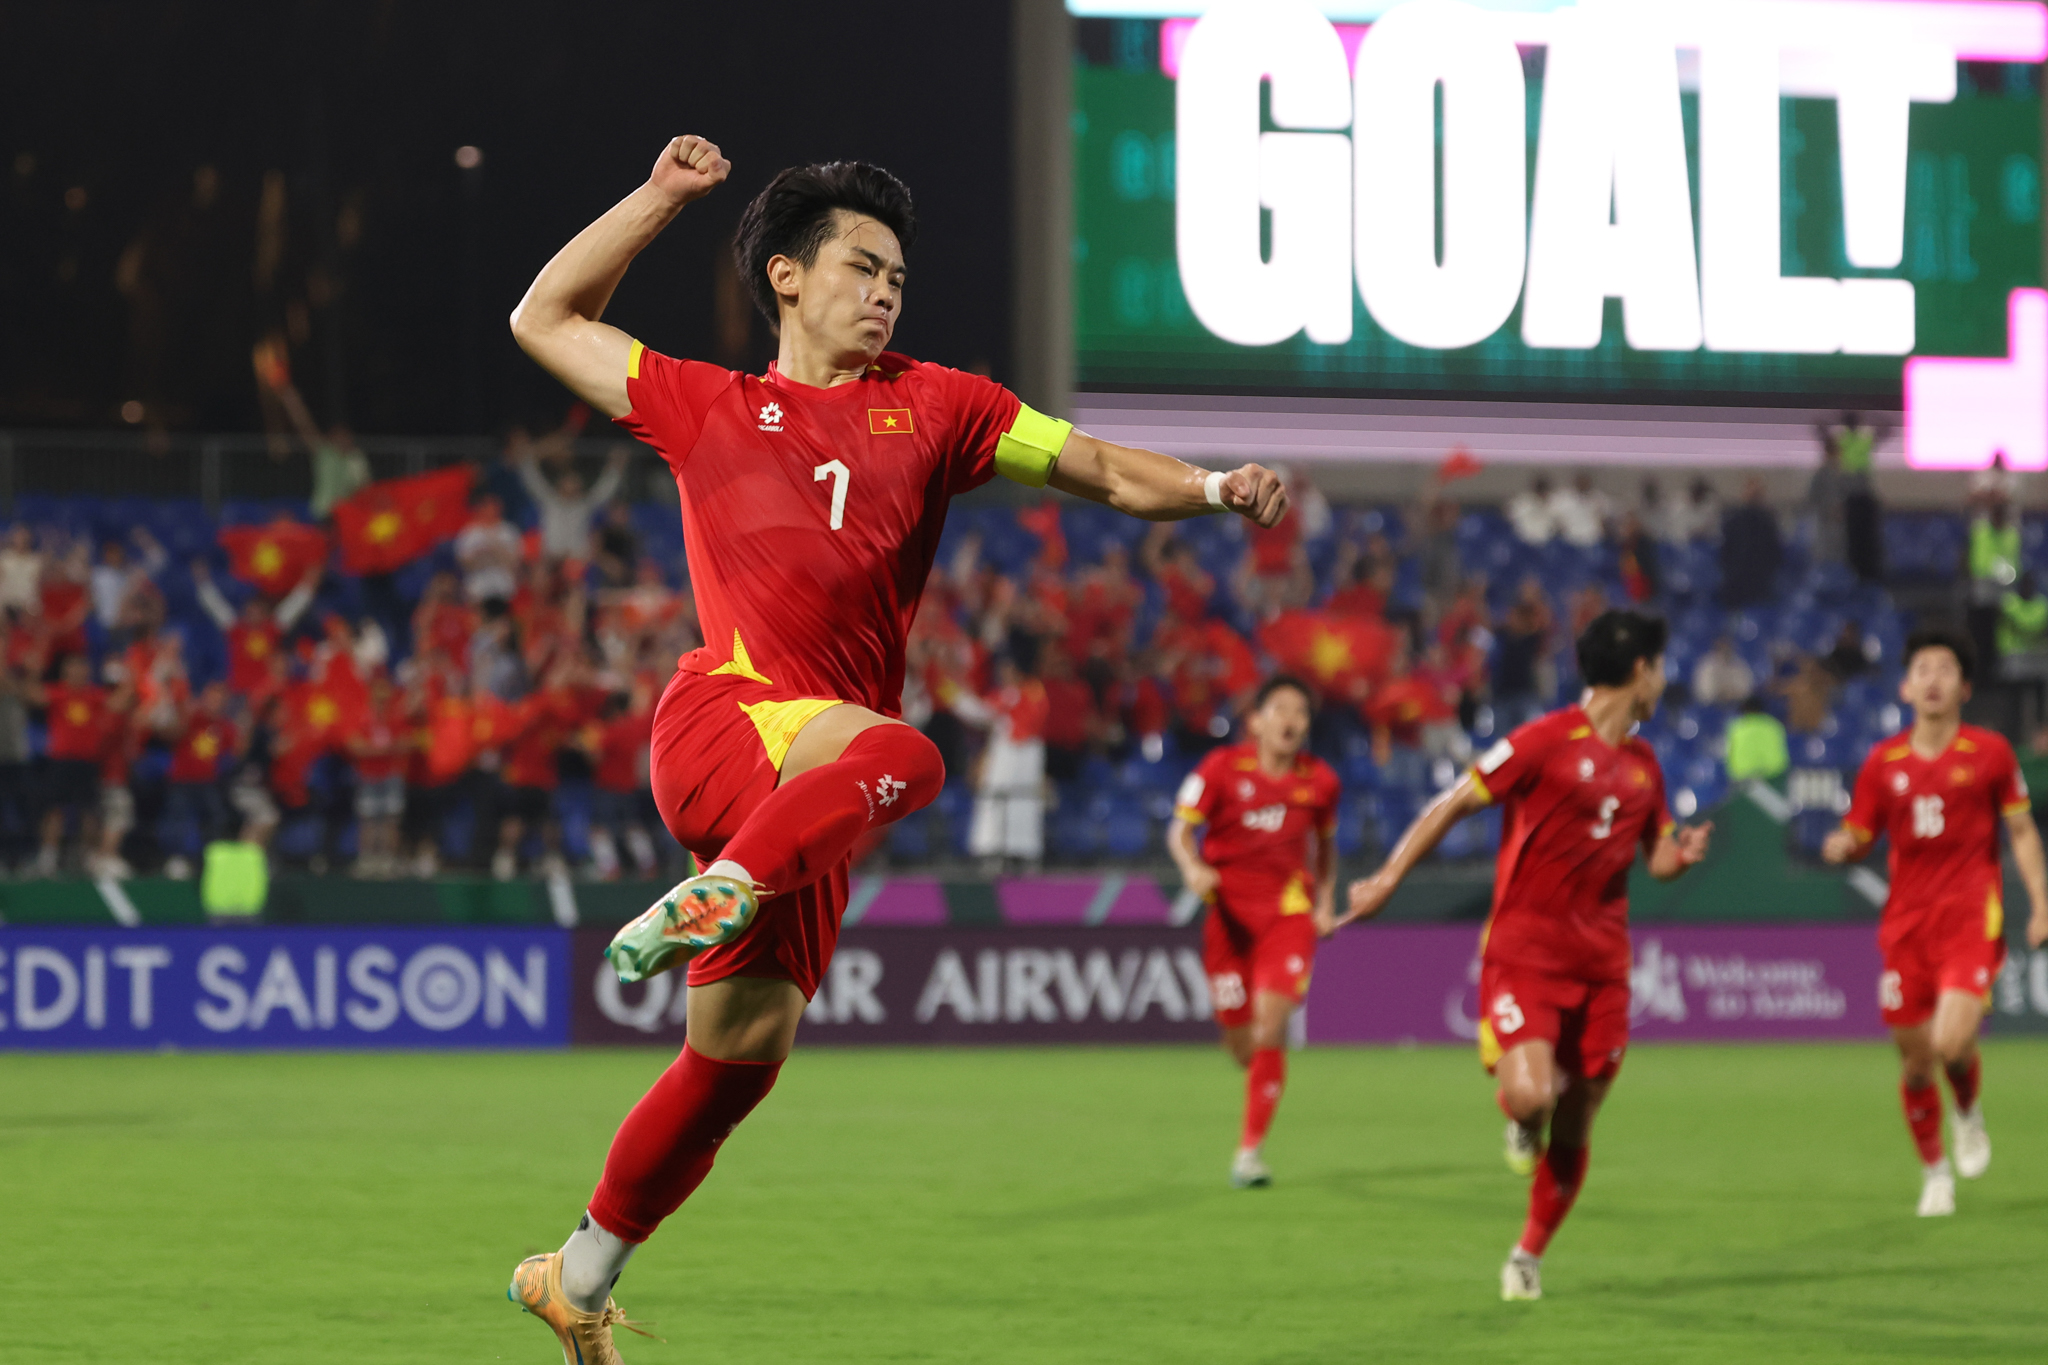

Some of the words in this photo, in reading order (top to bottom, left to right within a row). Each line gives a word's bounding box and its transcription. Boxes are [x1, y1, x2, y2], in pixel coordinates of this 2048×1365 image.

[814, 459, 850, 530] 7
[1912, 795, 1945, 839] 16
[0, 946, 173, 1031] DIT
[196, 945, 548, 1031] SAISON
[916, 947, 1213, 1024] AIRWAY
[1494, 993, 1525, 1034] 5
